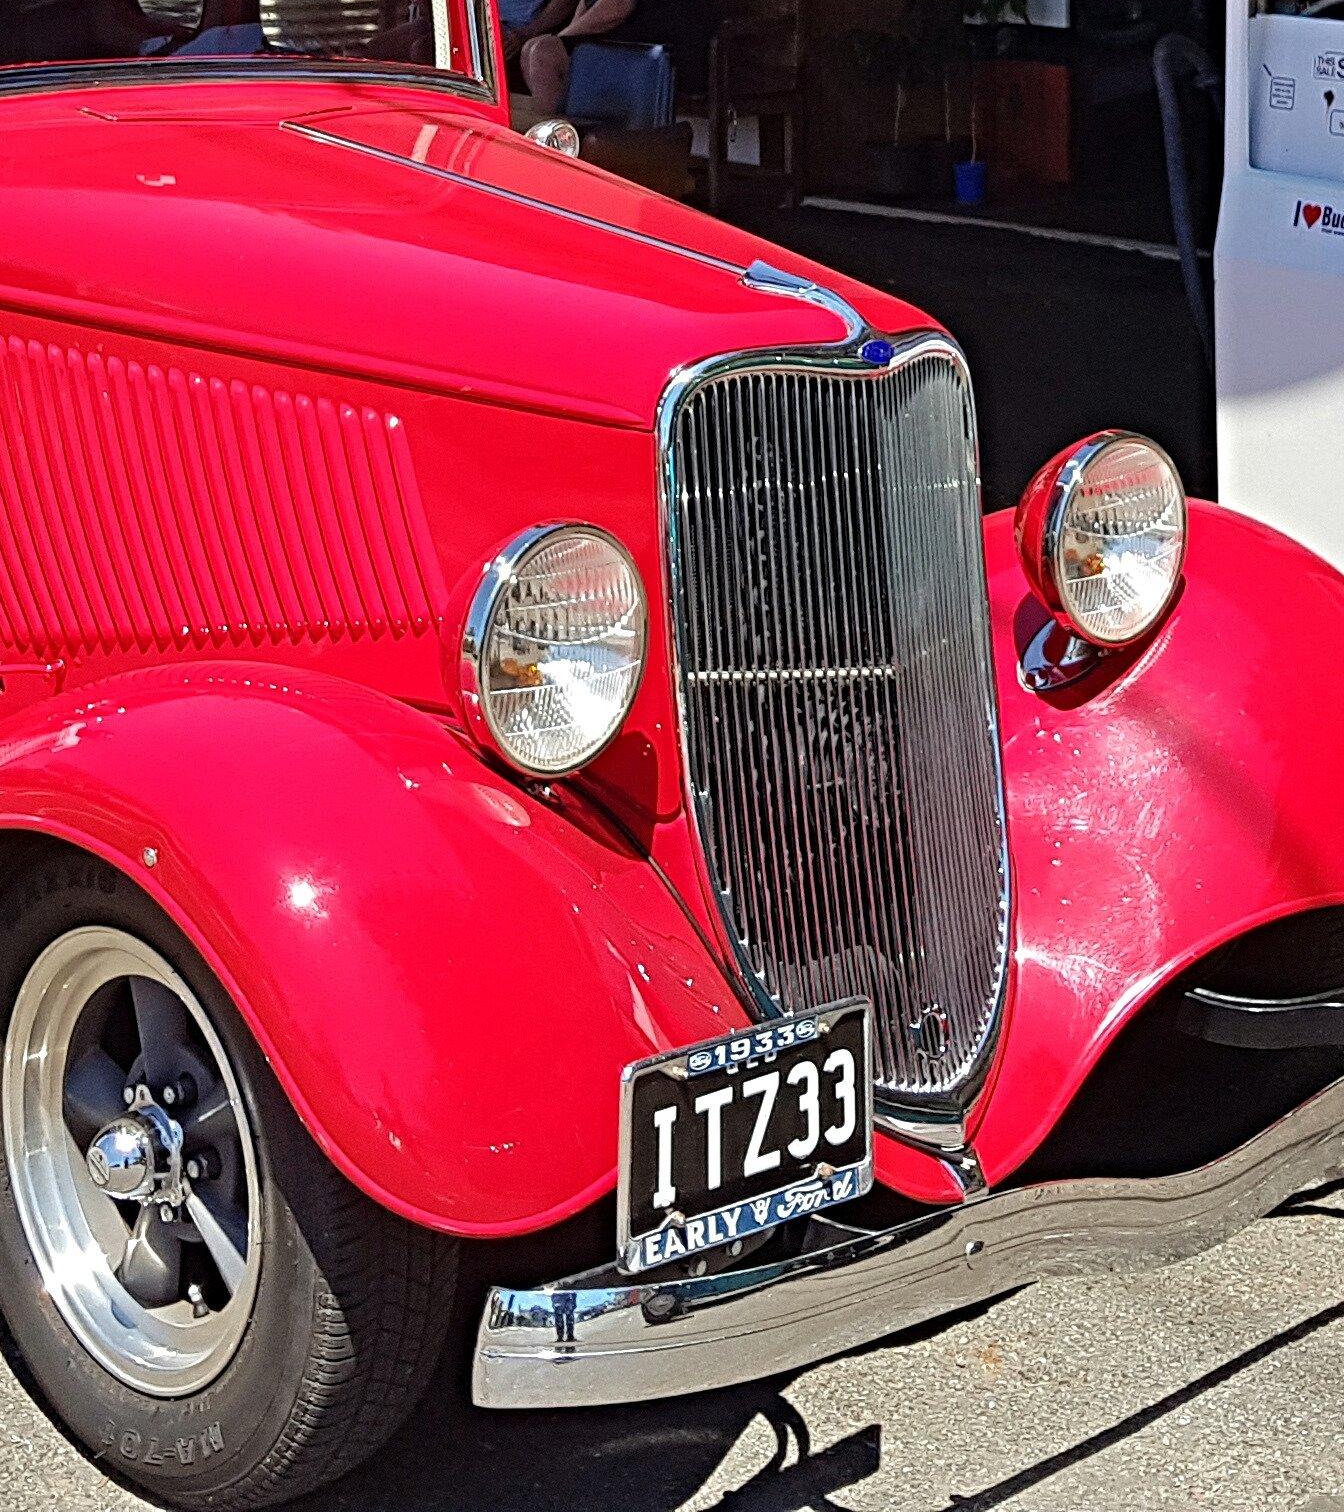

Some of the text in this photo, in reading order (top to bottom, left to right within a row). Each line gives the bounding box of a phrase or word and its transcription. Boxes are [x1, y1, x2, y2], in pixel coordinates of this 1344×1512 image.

[714, 1024, 796, 1066] 1933
[653, 1048, 857, 1209] ITZ33
[645, 1207, 745, 1266] EARLY
[777, 1171, 853, 1220] Ford
